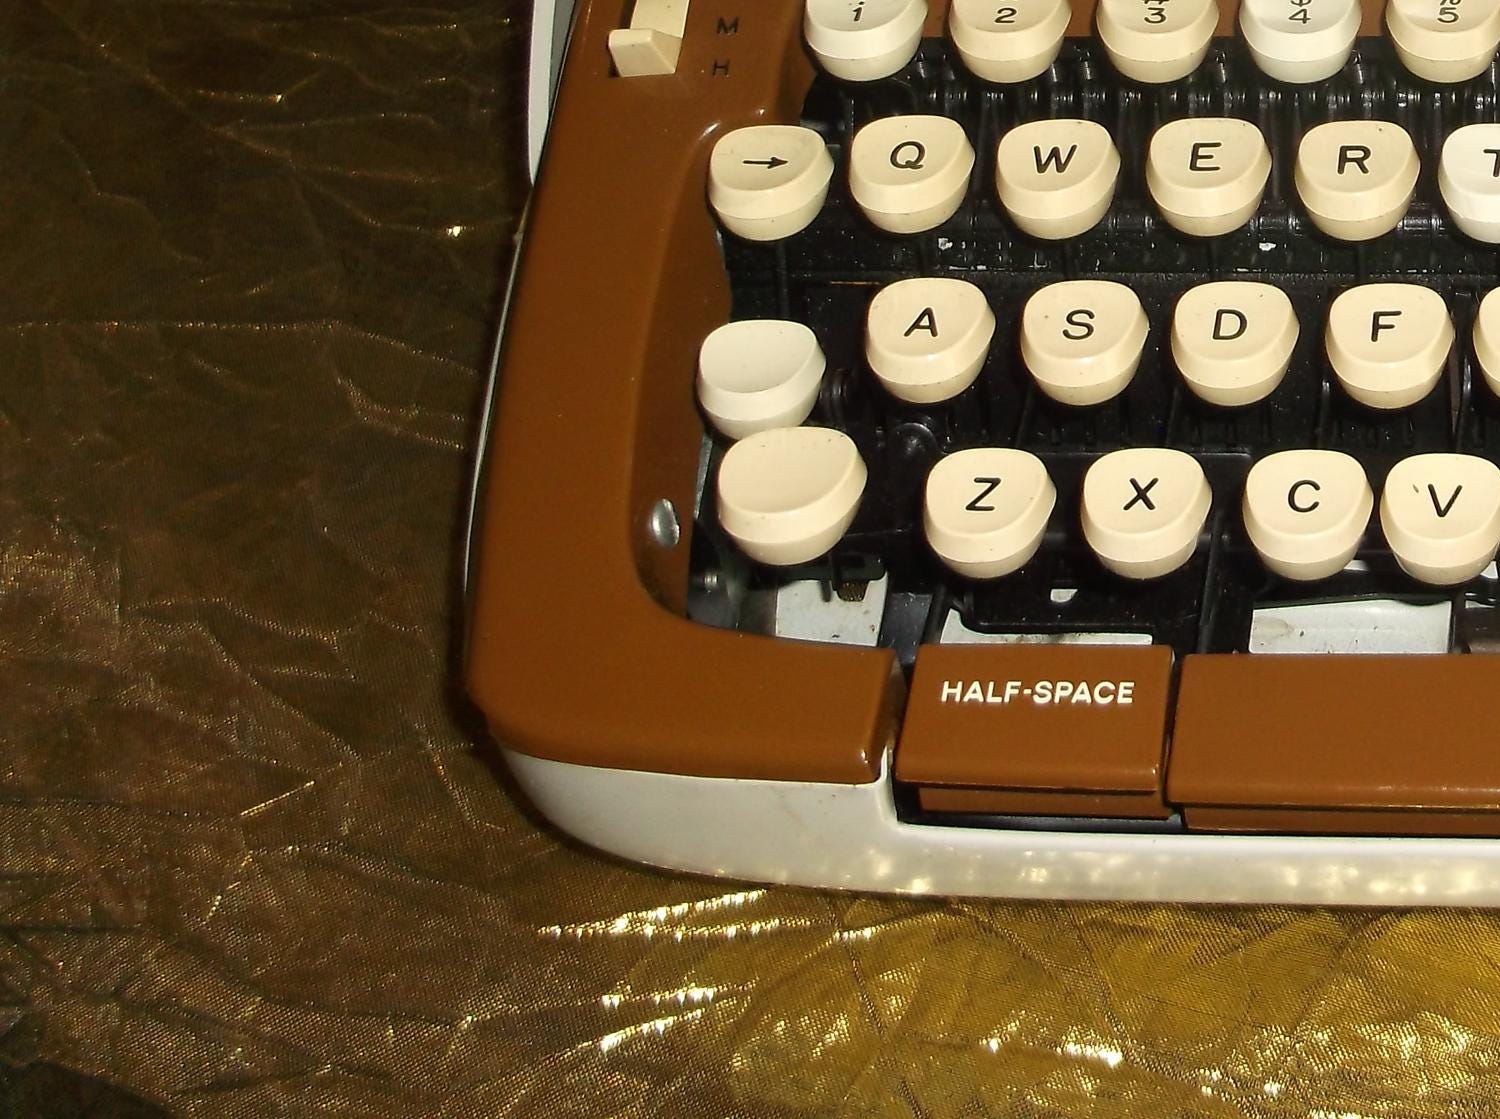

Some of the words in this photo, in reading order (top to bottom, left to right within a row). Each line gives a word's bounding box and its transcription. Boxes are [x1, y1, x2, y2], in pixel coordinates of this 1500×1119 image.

[715, 17, 740, 35] M
[853, 6, 863, 22] 1
[994, 7, 1017, 24] 2
[1144, 6, 1167, 24] 3
[1288, 7, 1311, 25] 4
[1437, 6, 1459, 24] 5
[711, 60, 730, 76] H
[889, 140, 926, 170] Q
[1033, 144, 1078, 174] W
[1189, 142, 1222, 172] E
[1337, 145, 1372, 175] R
[903, 307, 938, 338] A
[1062, 309, 1095, 341] S
[1212, 308, 1248, 341] D
[1370, 310, 1402, 343] F
[965, 477, 1002, 512] Z
[1123, 477, 1159, 511] X
[1287, 479, 1321, 514] C
[1427, 483, 1463, 518] V
[940, 680, 1135, 705] HALF-SPACE
